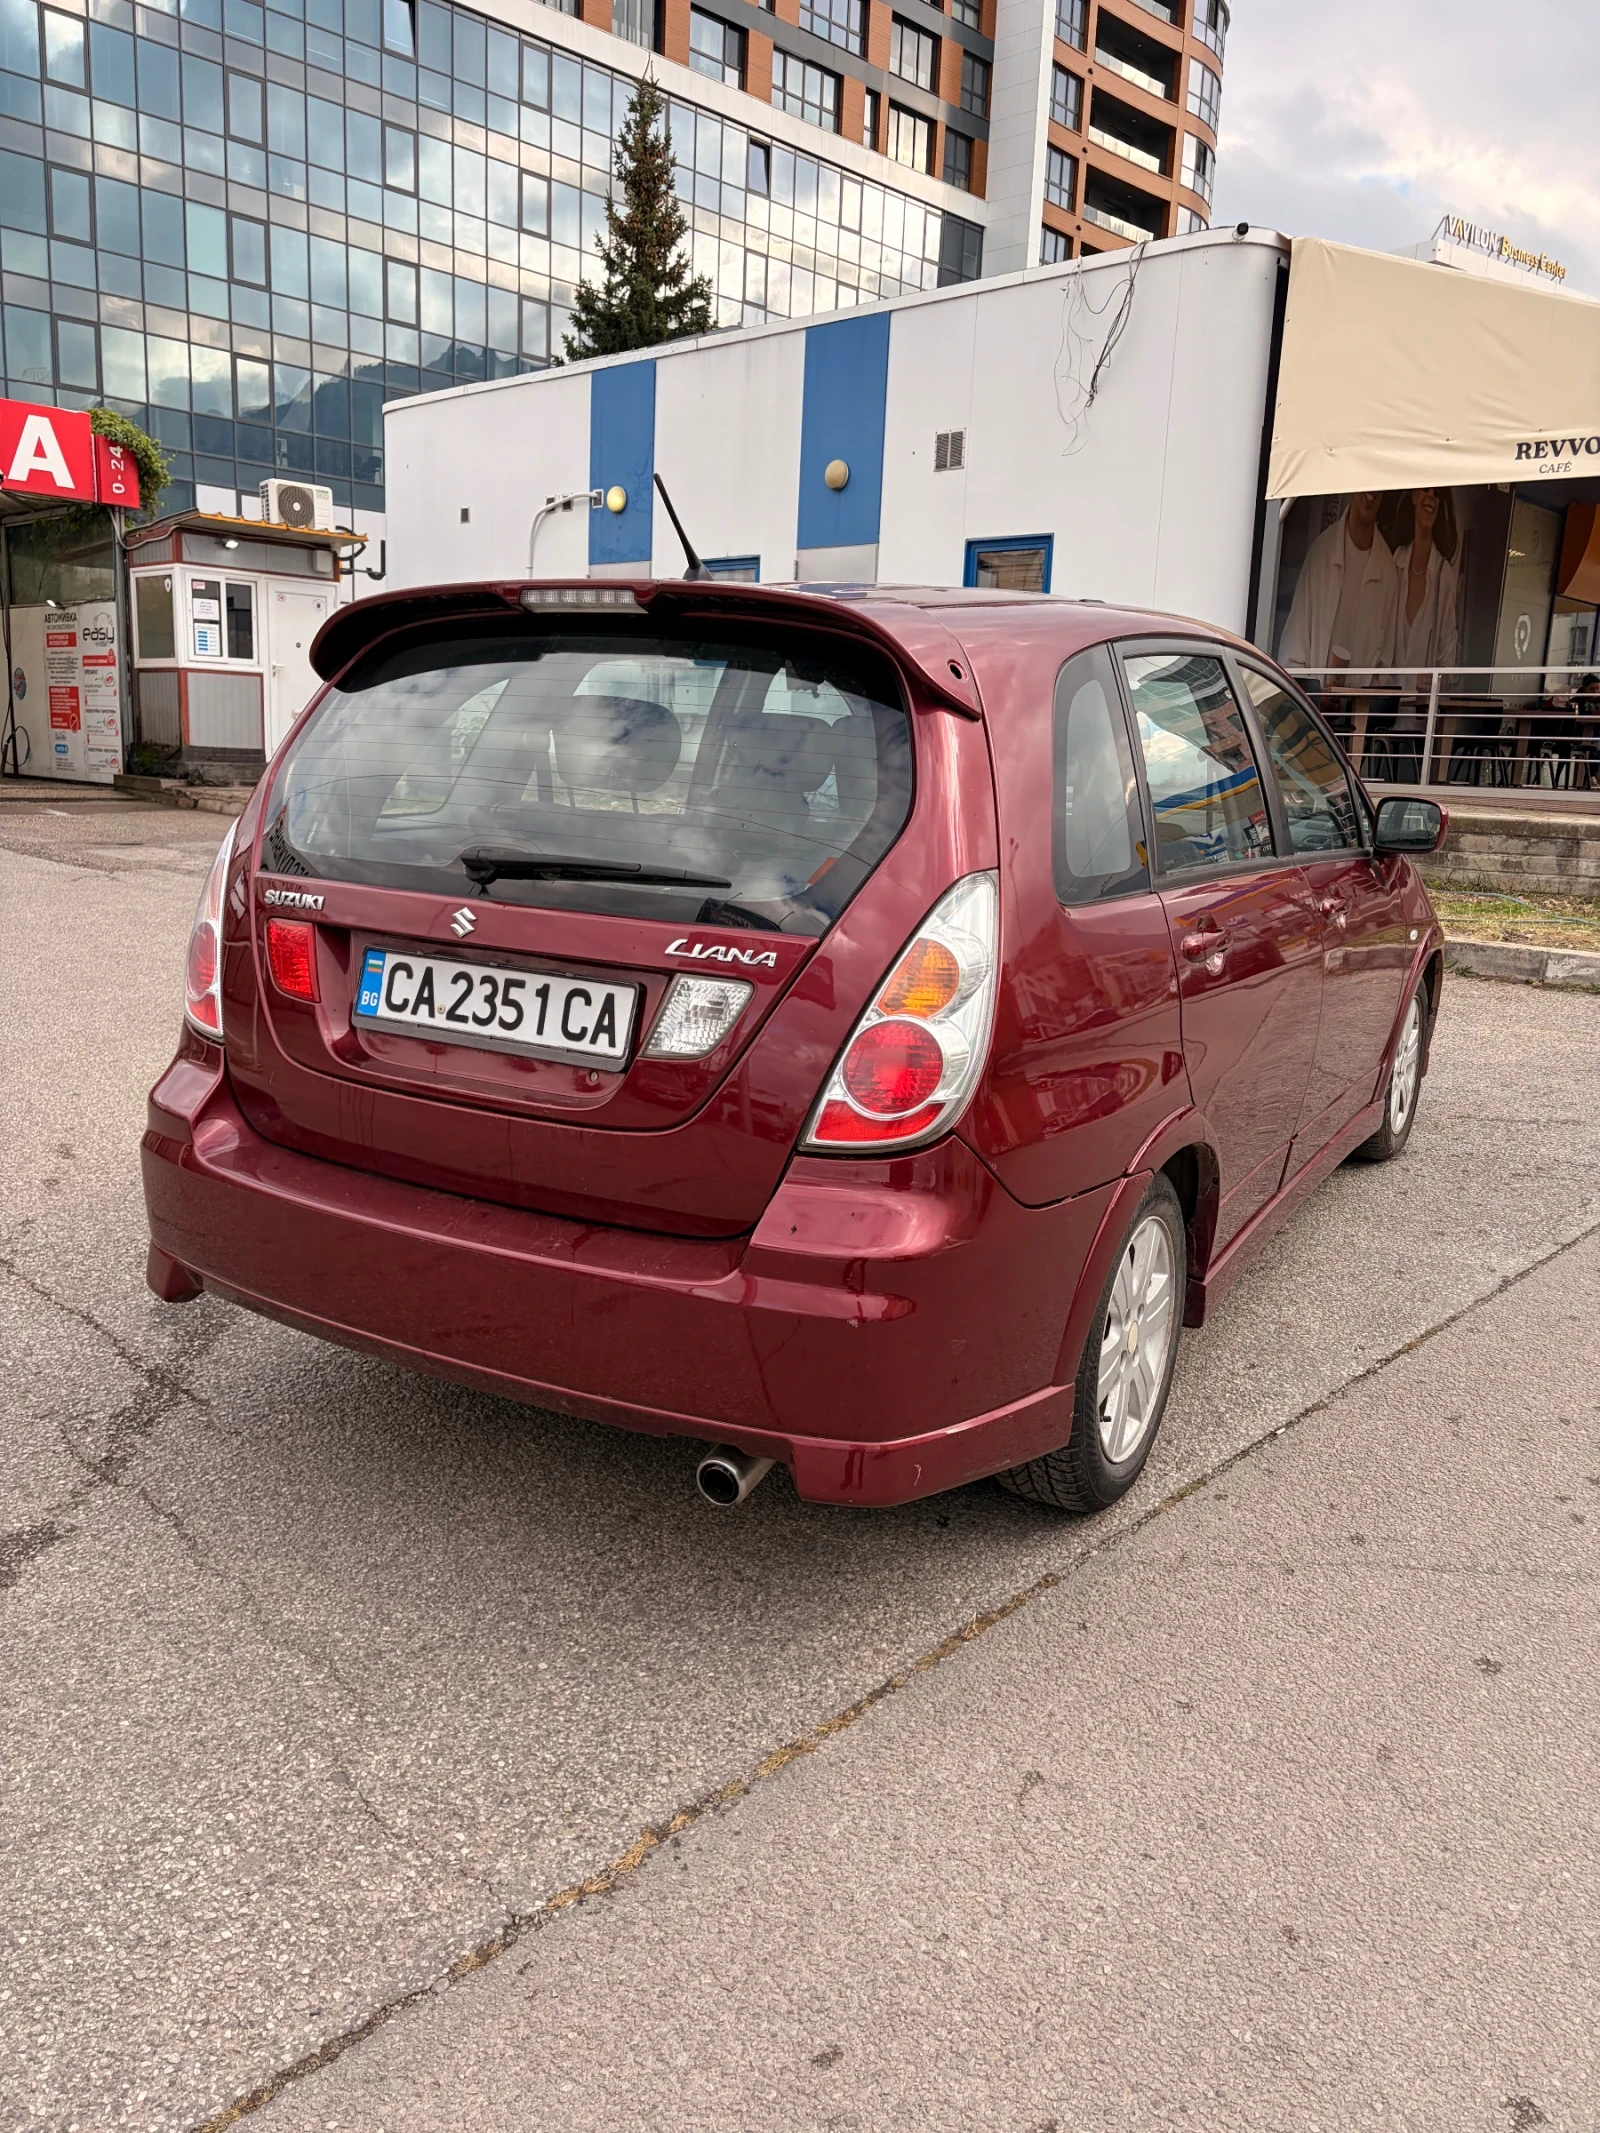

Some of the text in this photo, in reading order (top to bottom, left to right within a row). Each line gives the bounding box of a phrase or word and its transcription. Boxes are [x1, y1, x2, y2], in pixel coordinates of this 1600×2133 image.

[1446, 214, 1567, 279] VAVILON Business Center
[1515, 436, 1600, 460] REVVO
[1539, 460, 1572, 474] CAFÉ
[82, 627, 115, 643] easy
[264, 889, 325, 911] SUZUKI
[664, 938, 777, 968] LIANA
[360, 990, 378, 1007] BG
